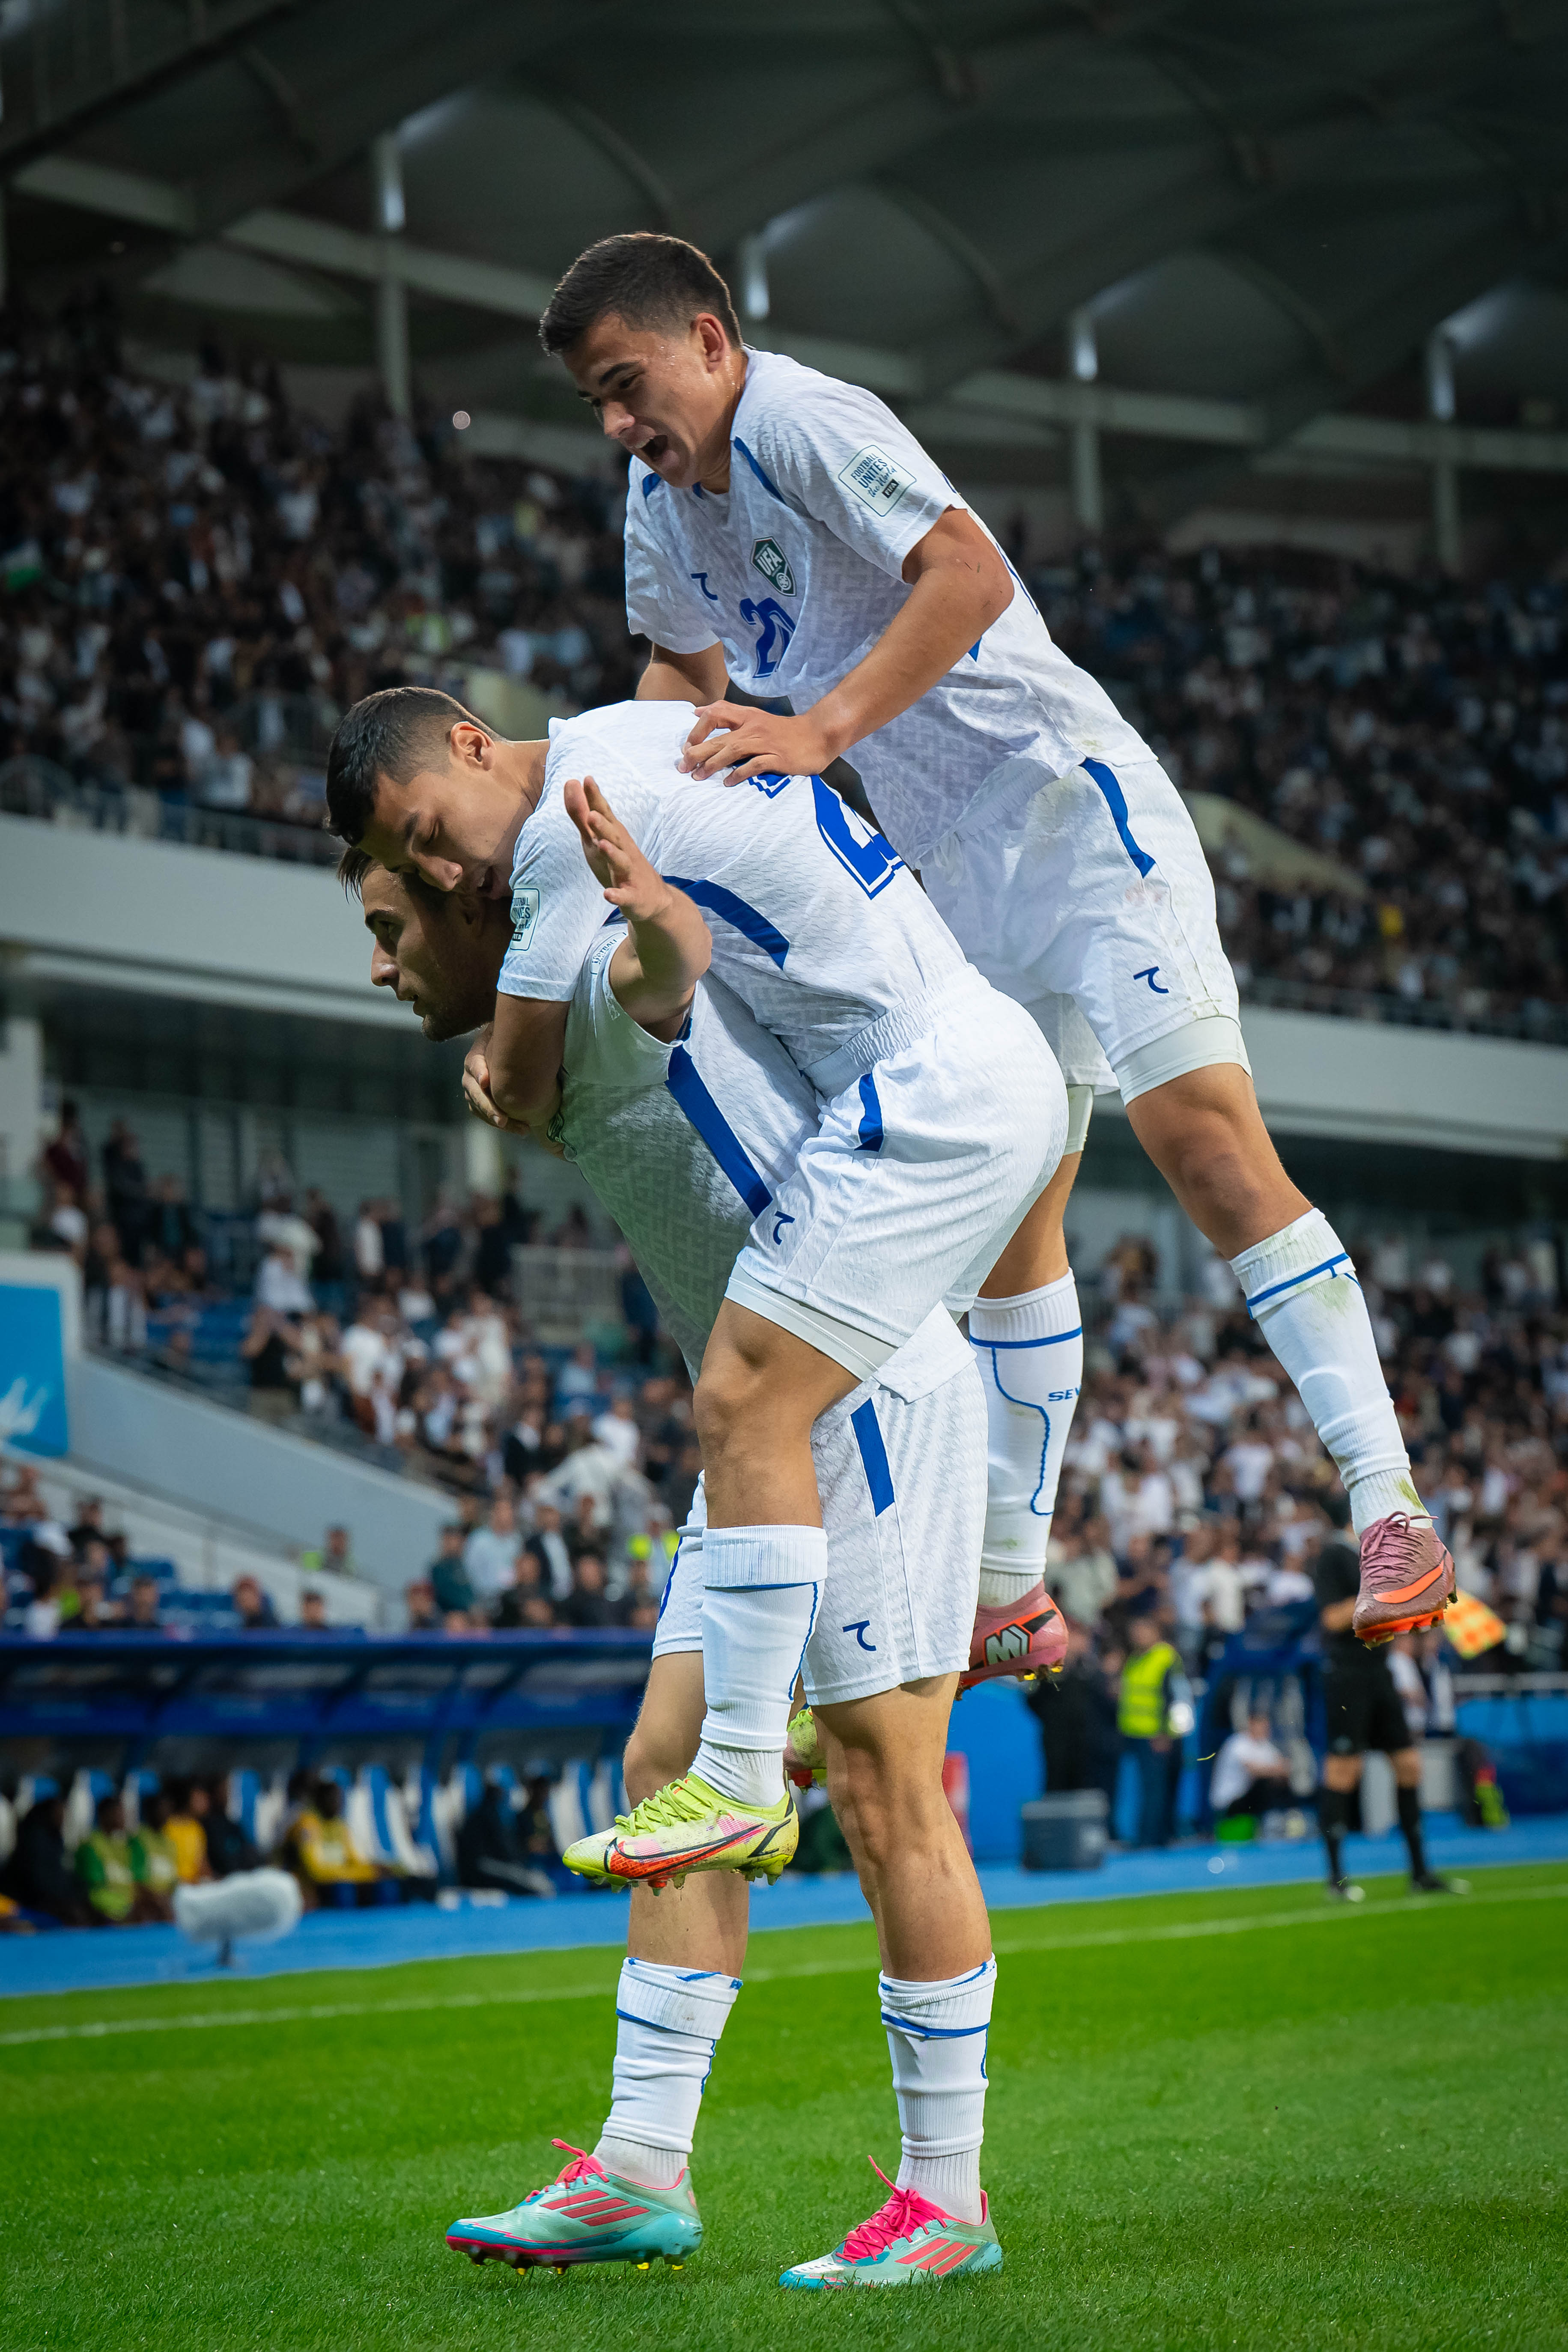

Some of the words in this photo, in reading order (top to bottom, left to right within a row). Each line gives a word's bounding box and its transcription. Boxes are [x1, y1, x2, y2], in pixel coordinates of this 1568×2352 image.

[850, 453, 879, 480] FOOTBALL
[858, 459, 887, 488] UNITES
[867, 487, 879, 498] the
[876, 465, 897, 487] World
[884, 482, 897, 496] FIFA
[756, 547, 783, 576] UFA
